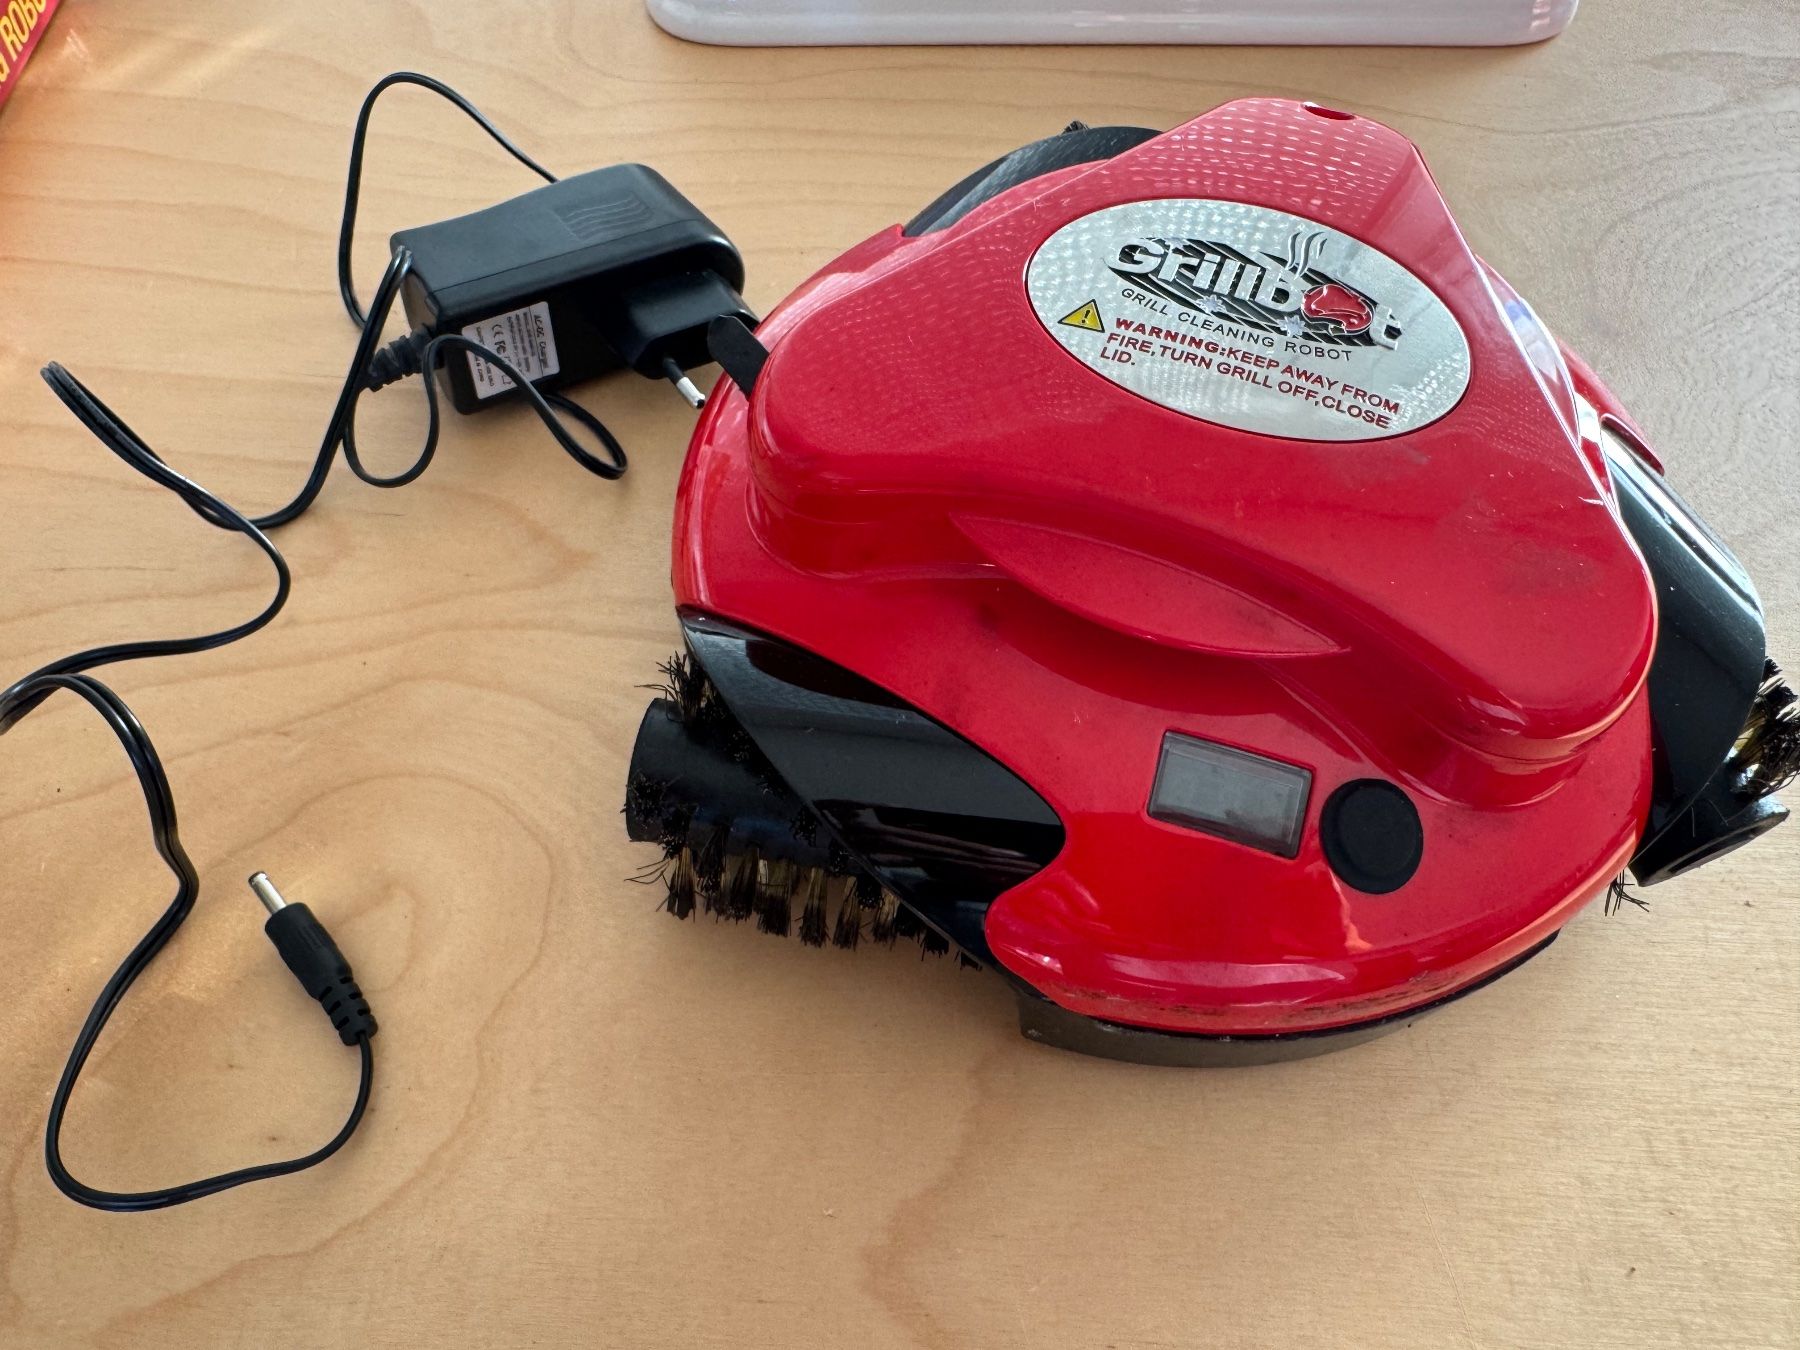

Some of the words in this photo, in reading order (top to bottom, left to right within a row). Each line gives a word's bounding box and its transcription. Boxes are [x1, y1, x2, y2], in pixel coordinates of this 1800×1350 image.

[1121, 288, 1168, 315] GRILL
[1178, 312, 1275, 347] CLEANING
[1284, 341, 1352, 361] ROBOT
[1100, 346, 1136, 365] LID.
[1216, 362, 1273, 389] GRILL
[1281, 365, 1339, 391] AWAY
[1341, 384, 1400, 415] FROM
